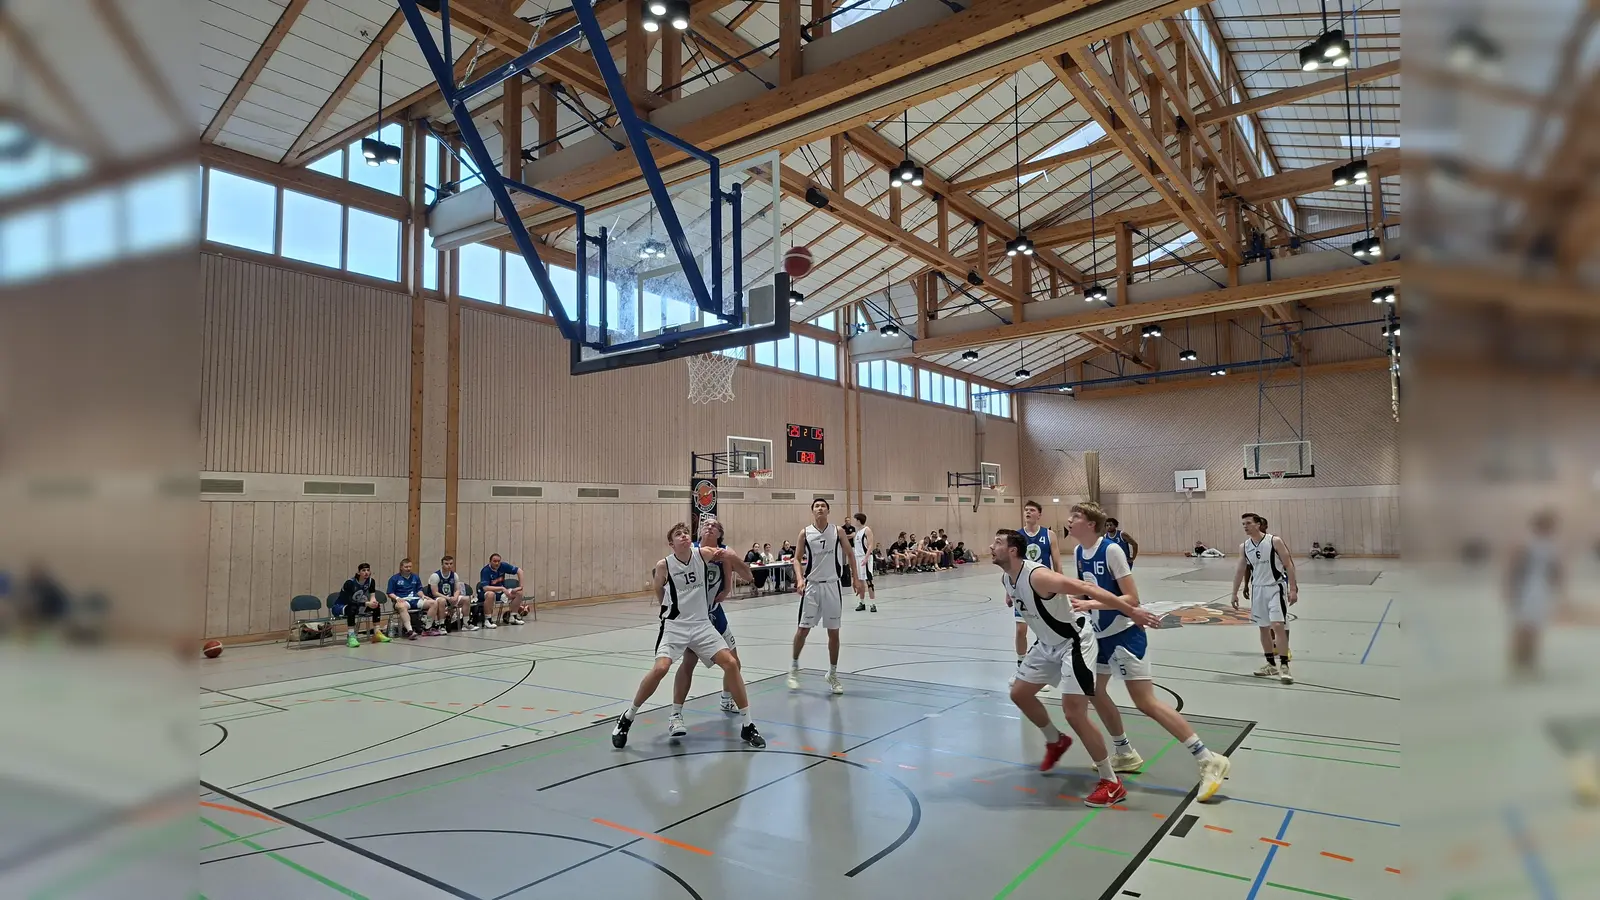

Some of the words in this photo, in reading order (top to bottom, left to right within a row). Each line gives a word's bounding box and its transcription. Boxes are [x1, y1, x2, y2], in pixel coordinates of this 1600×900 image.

[804, 428, 808, 437] 2
[820, 540, 826, 550] 7
[1039, 536, 1046, 545] 4
[1255, 551, 1262, 560] 6
[1093, 560, 1105, 575] 16
[684, 571, 697, 585] 15
